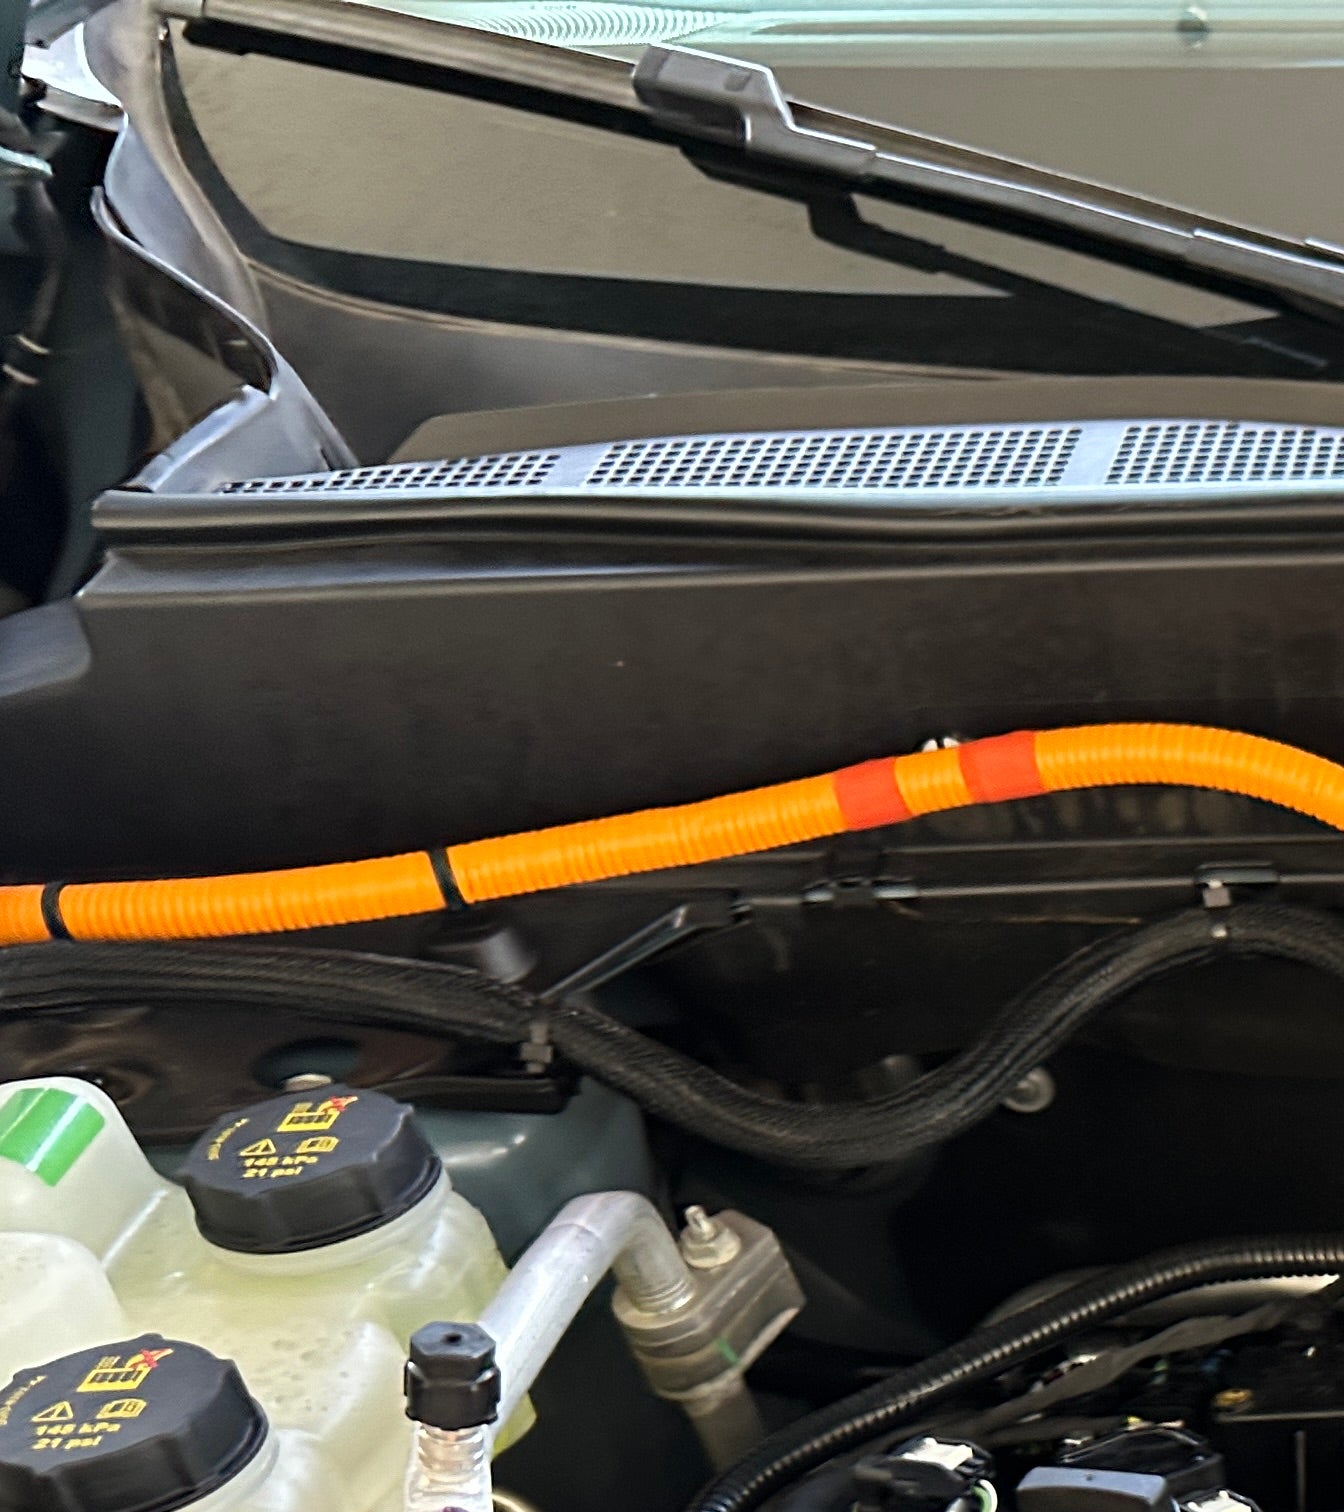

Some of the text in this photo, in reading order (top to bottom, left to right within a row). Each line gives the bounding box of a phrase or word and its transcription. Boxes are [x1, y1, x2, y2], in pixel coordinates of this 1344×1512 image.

[281, 1155, 318, 1166] kPa
[242, 1165, 303, 1178] 21 psi
[78, 1421, 121, 1434] kPa
[32, 1435, 103, 1449] 21 psi
